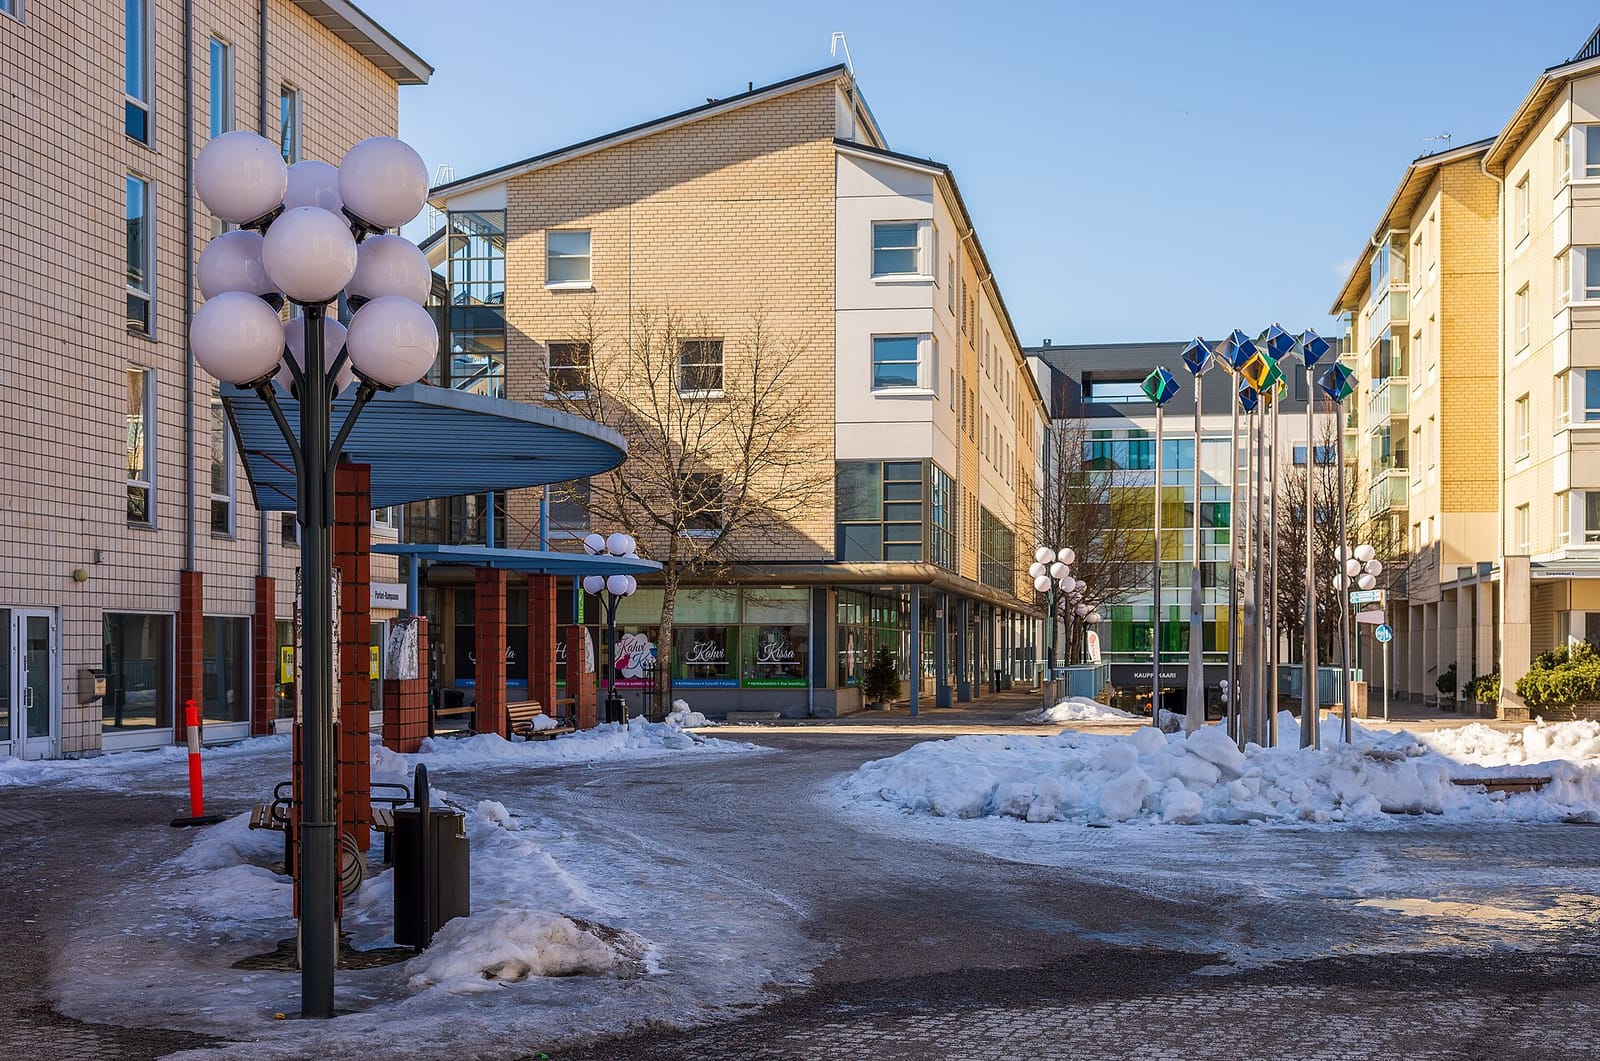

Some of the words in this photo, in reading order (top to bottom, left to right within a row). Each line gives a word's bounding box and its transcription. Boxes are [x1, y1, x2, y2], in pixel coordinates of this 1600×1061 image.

[615, 637, 645, 661] Kahvi
[686, 642, 726, 661] Kahvi
[756, 641, 795, 661] Kissa
